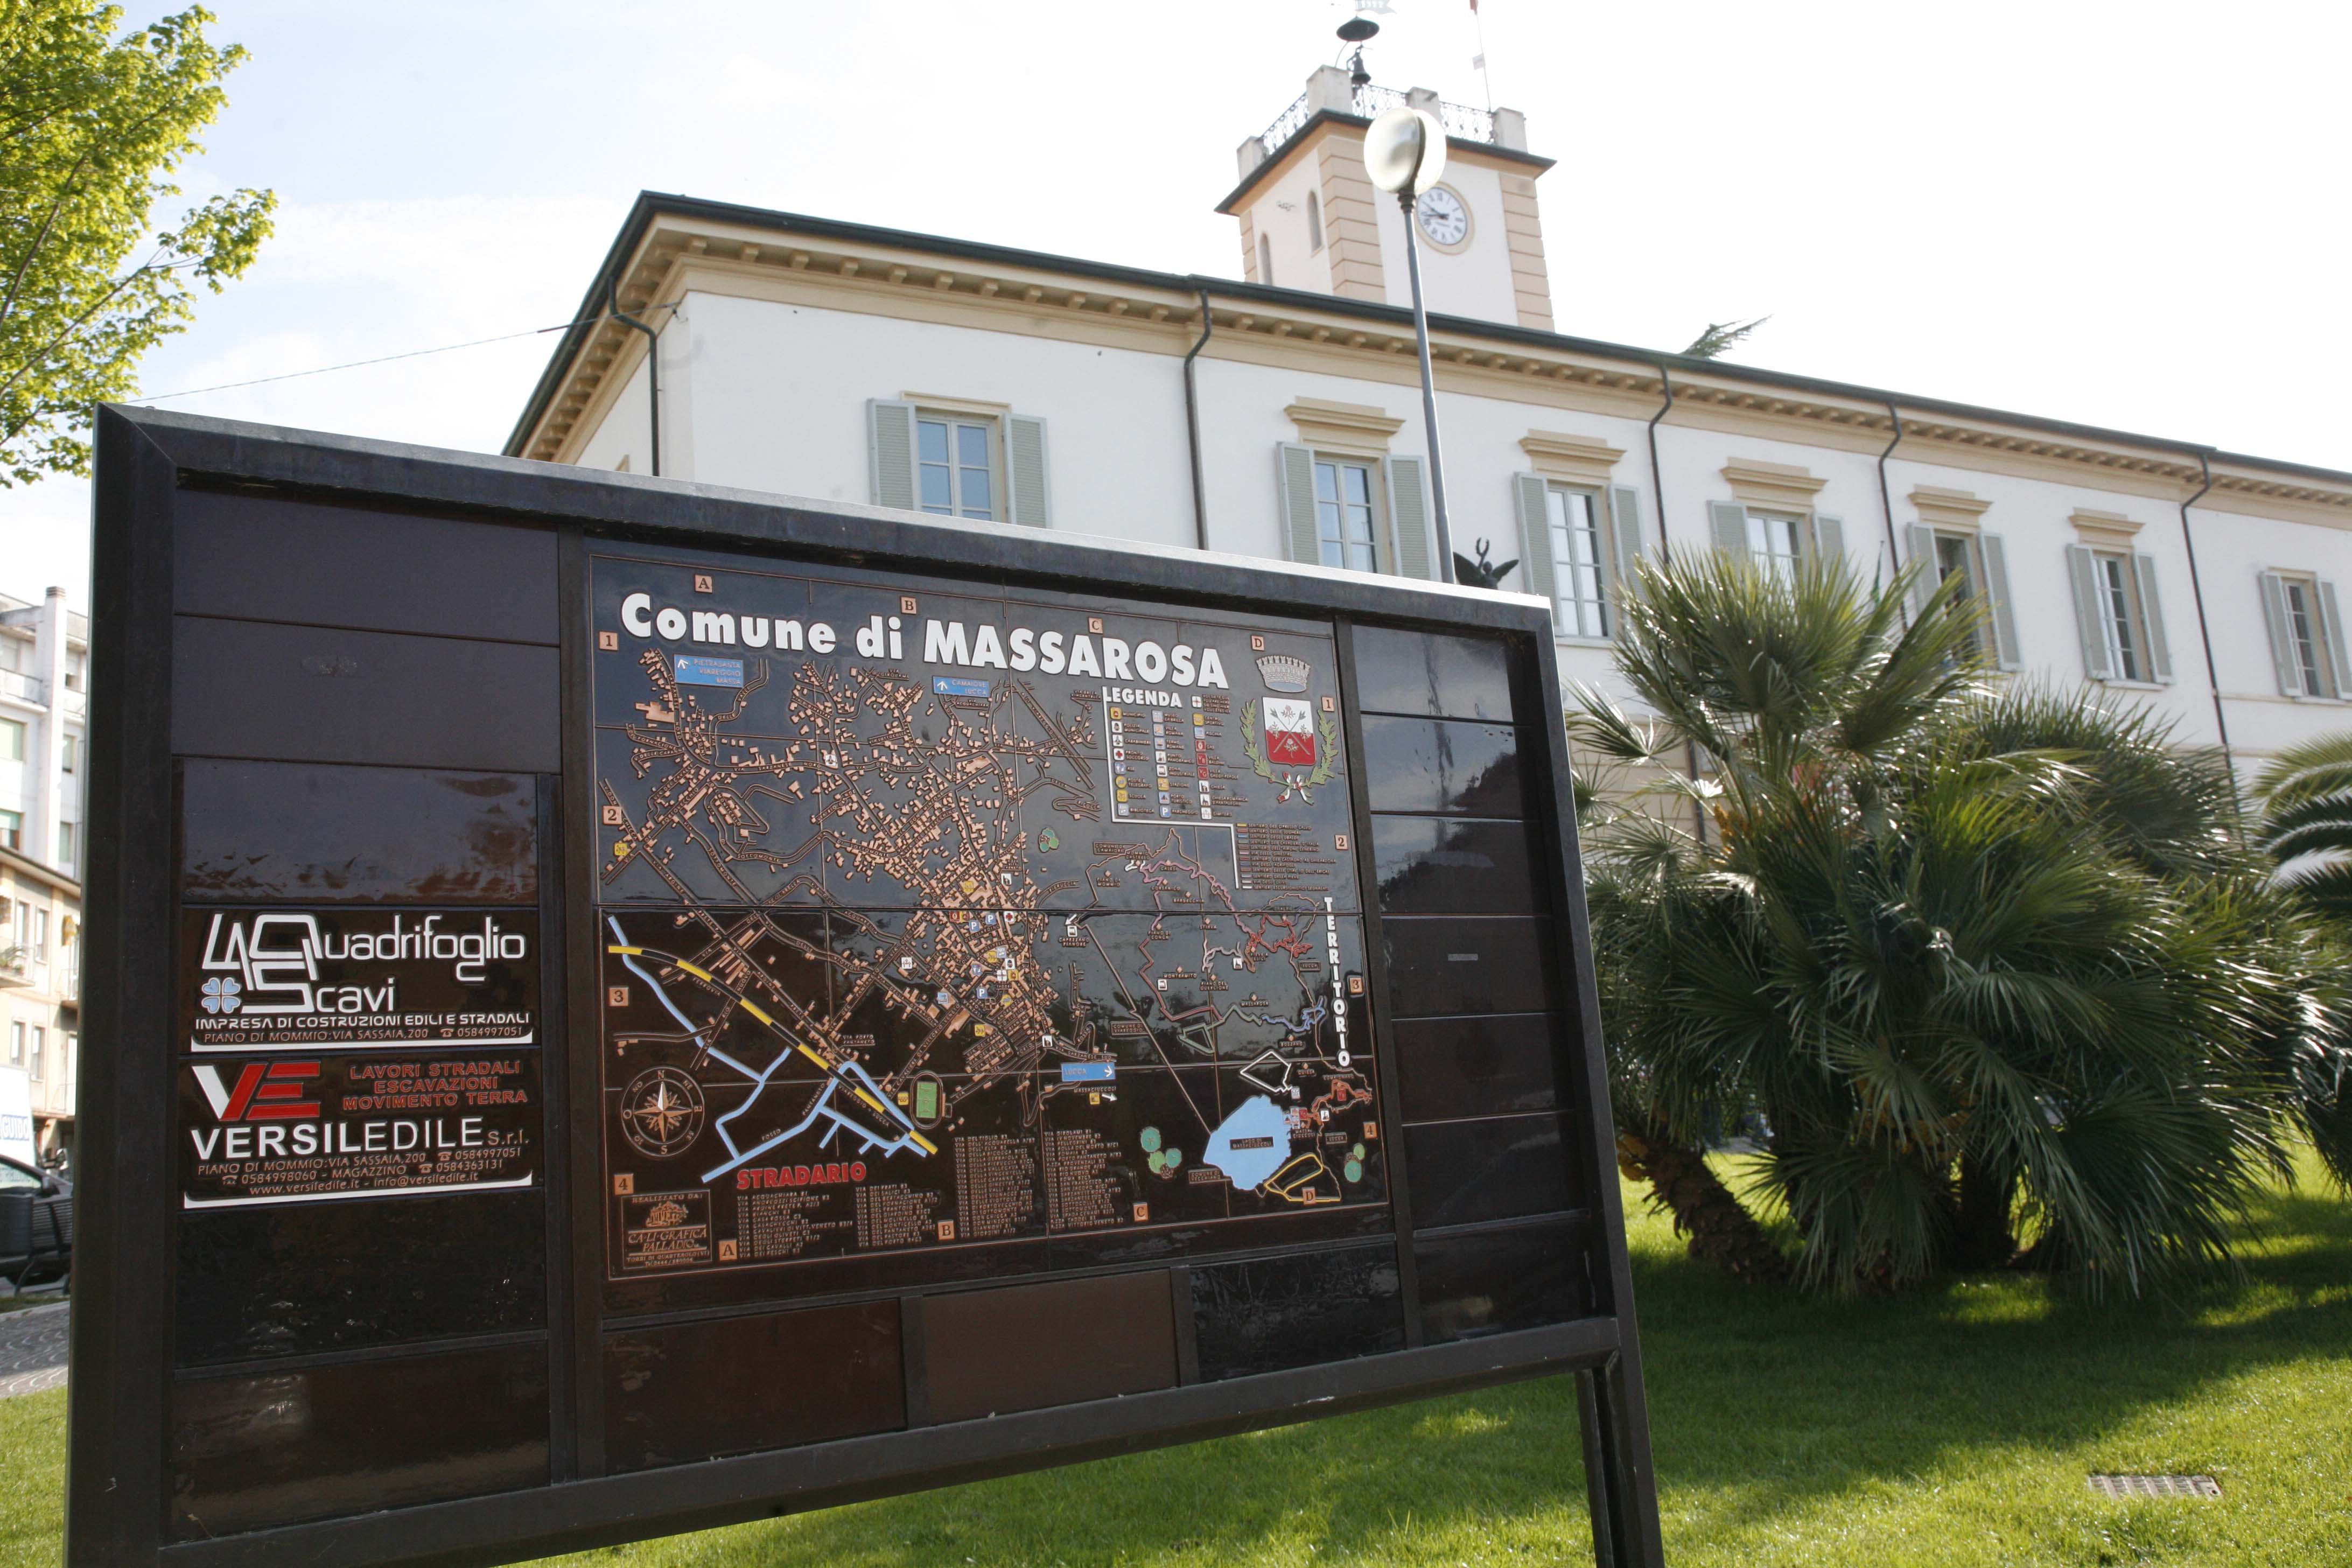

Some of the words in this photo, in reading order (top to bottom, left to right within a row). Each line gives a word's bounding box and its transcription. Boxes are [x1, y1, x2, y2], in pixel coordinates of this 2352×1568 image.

[698, 578, 711, 590] A
[904, 600, 914, 611] B
[1091, 619, 1102, 632] C
[604, 635, 612, 647] 1
[621, 593, 836, 654] Comune
[856, 614, 903, 660] di
[923, 618, 1229, 689] MASSAROSA
[1252, 638, 1263, 649] D
[694, 659, 741, 668] PIETRASANTA
[699, 668, 741, 677] VIAREGGIO
[951, 680, 987, 688] CAMAIORE
[1102, 687, 1182, 708] LEGENDA
[1325, 699, 1332, 710] 1
[758, 762, 792, 771] SARZANESE
[607, 809, 617, 821] 2
[1338, 837, 1345, 847] 2
[249, 912, 527, 982] Quadrifoglio
[241, 961, 397, 1014] Scavi
[1324, 897, 1350, 1067] TERRITORIO
[1353, 981, 1360, 990] 3
[613, 990, 624, 1004] 3
[195, 1018, 273, 1030] IMPRESA
[277, 1017, 292, 1028] DI
[297, 1014, 401, 1028] COSTRUZIONI
[404, 1013, 443, 1025] EDILI
[446, 1013, 456, 1025] E
[459, 1012, 529, 1024] STRADALI
[204, 1032, 246, 1044] PIANO
[250, 1032, 264, 1042] DI
[457, 1026, 523, 1038] 0584997051
[349, 1063, 421, 1080] LAVORI
[428, 1060, 521, 1077] STRADALI
[657, 1070, 665, 1080] N
[373, 1076, 499, 1095] ESCAVAZIONI
[342, 1093, 458, 1111] MOVIMENTO
[466, 1089, 529, 1105] TERRA
[622, 1109, 632, 1119] O
[1367, 1125, 1373, 1136] 4
[191, 1116, 484, 1160] VERSILEDILE
[661, 1145, 668, 1154] S
[198, 1163, 240, 1176] PIANO
[245, 1161, 259, 1172] DI
[455, 1147, 521, 1160] 0584997051
[241, 1170, 317, 1185] 0584998060
[332, 1165, 408, 1179] MAGAZZINO
[436, 1159, 503, 1173] 0584363131
[737, 1162, 867, 1189] STRADARIO
[249, 1178, 360, 1195] www.versiledile.it
[374, 1172, 479, 1188] info@versiledile.it
[618, 1178, 628, 1191] 4
[1306, 1191, 1315, 1201] D
[1136, 1205, 1146, 1217] C
[942, 1224, 952, 1236] B
[722, 1241, 736, 1257] A
